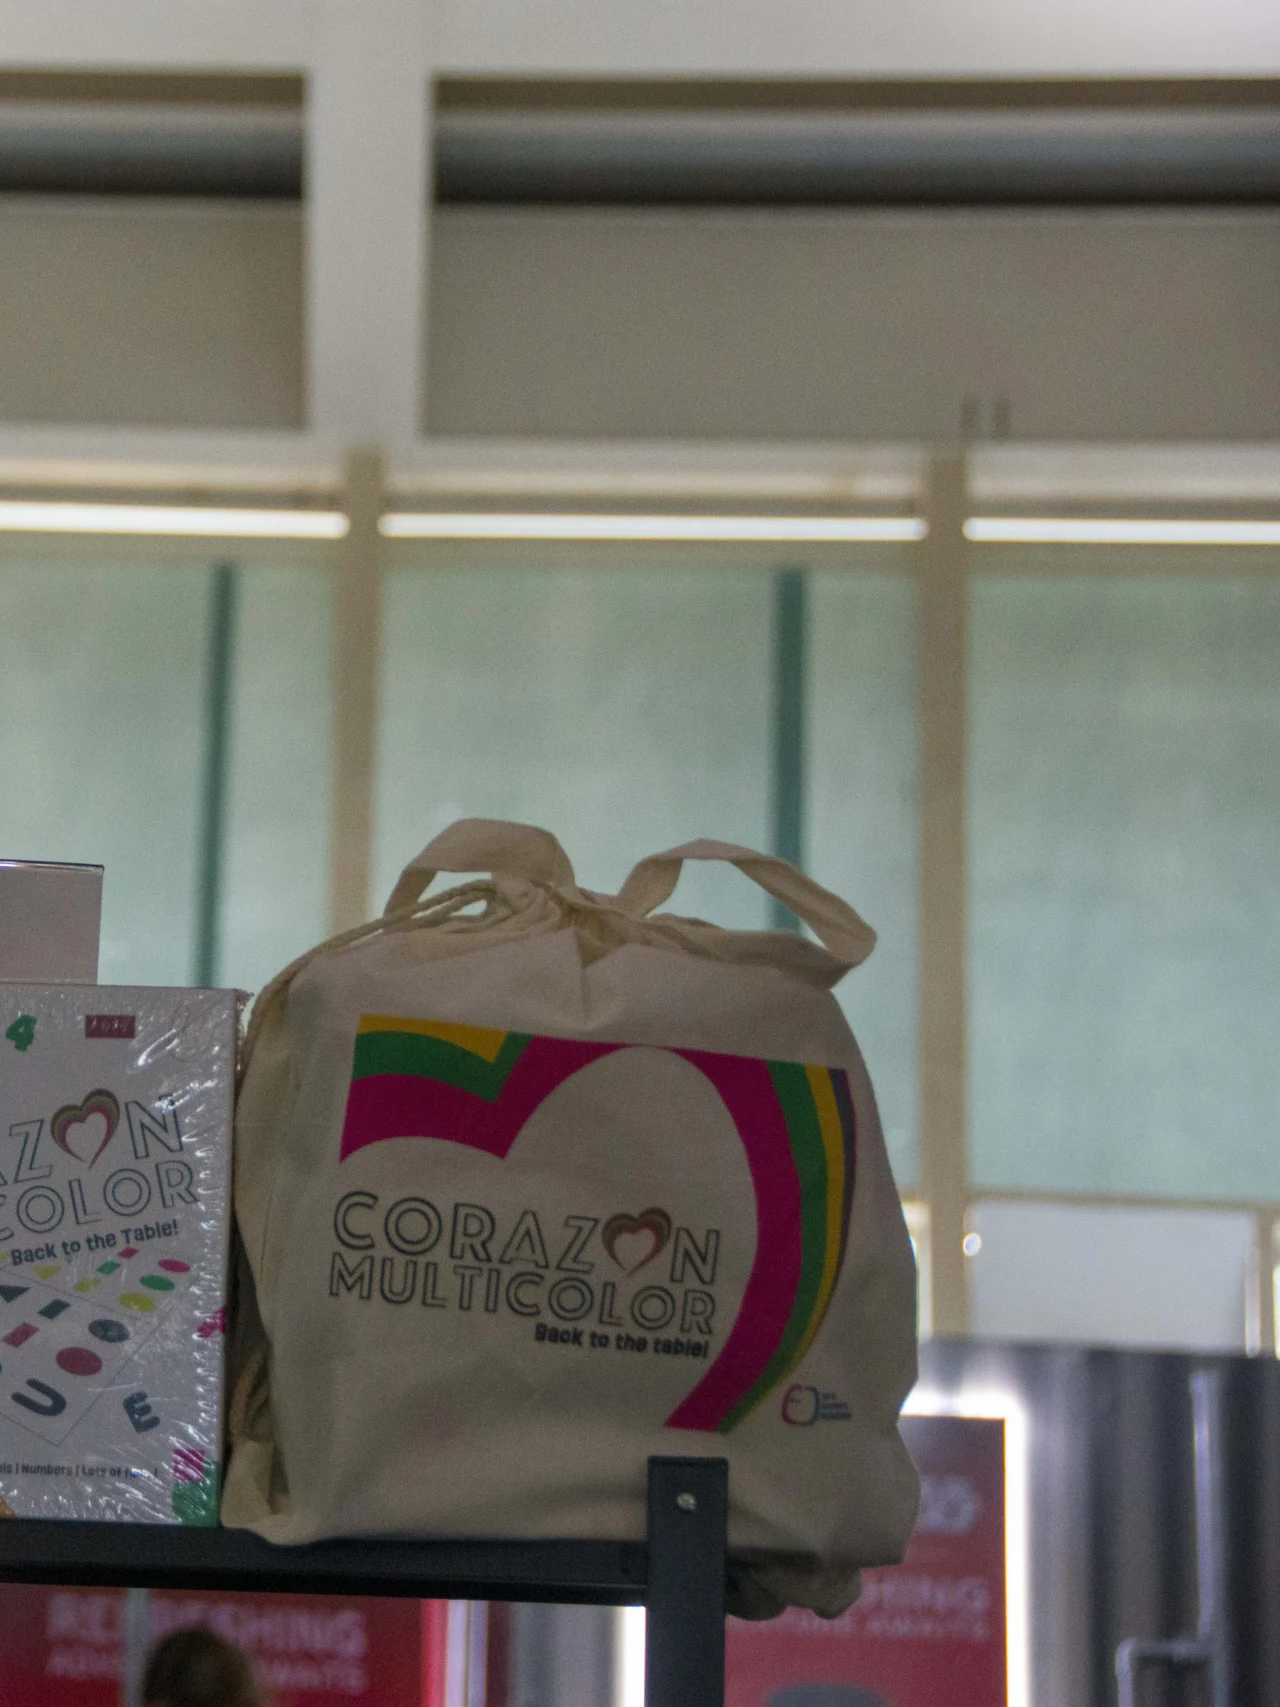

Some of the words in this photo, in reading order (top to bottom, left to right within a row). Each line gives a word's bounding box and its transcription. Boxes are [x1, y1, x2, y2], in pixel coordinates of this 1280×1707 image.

[11, 1243, 57, 1266] Back
[61, 1240, 81, 1255] to
[86, 1233, 117, 1251] the
[121, 1219, 179, 1244] Table!
[329, 1252, 717, 1335] MULTICOLOR
[535, 1322, 584, 1347] Back
[589, 1331, 610, 1348] to
[615, 1333, 648, 1353] the
[653, 1337, 709, 1359] table!
[22, 1462, 73, 1476] Numbers
